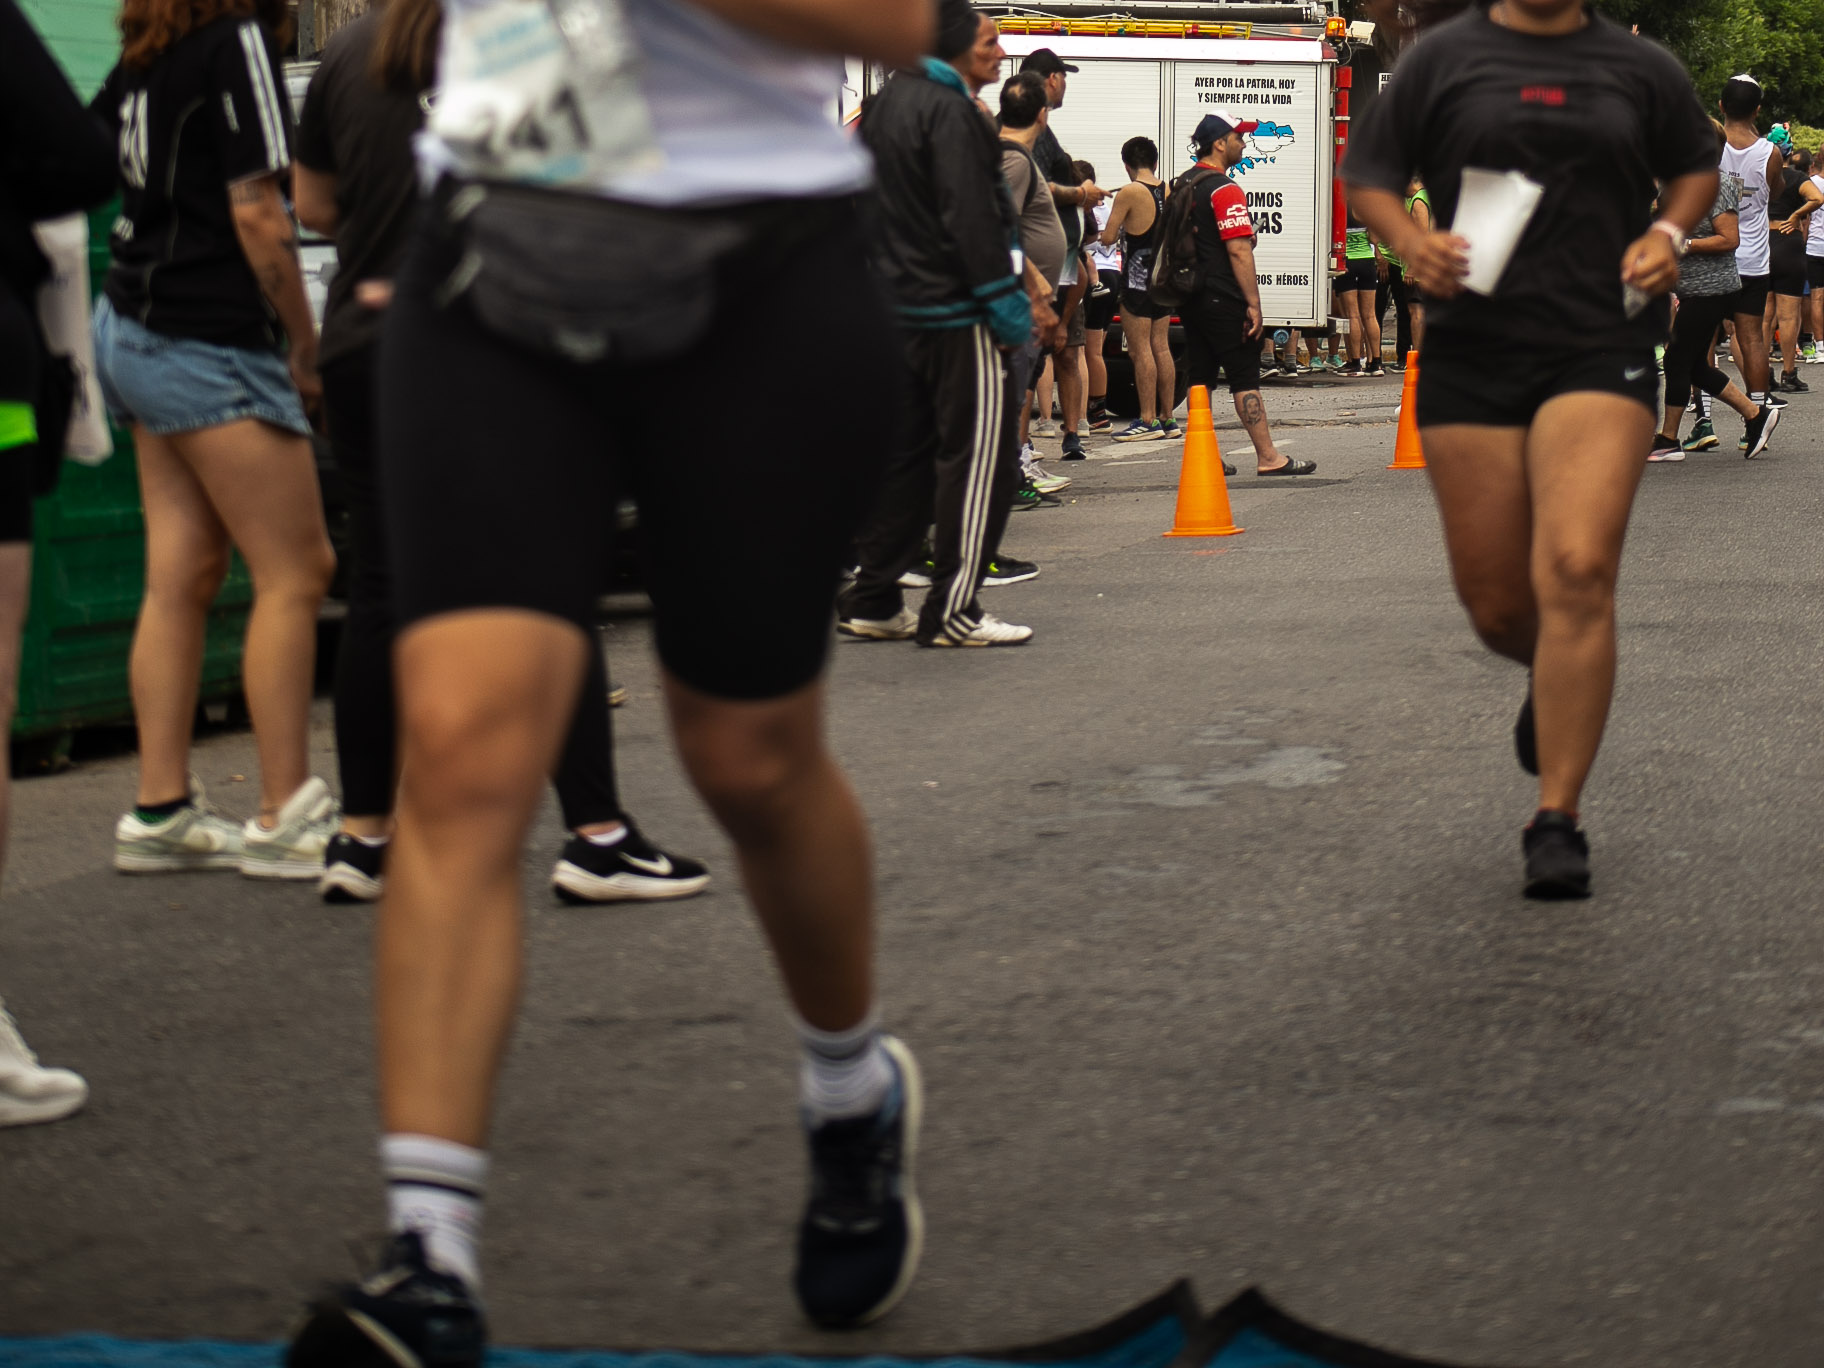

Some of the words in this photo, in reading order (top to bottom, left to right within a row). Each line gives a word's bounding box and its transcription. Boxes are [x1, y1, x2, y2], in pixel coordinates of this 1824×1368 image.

[1194, 77, 1214, 87] AYER
[1216, 78, 1233, 88] POR
[1235, 78, 1245, 88] LA
[1246, 78, 1277, 90] PATRIA,
[1279, 79, 1295, 89] HOY
[1198, 93, 1203, 103] Y
[1204, 93, 1240, 103] SIEMPRE
[1242, 94, 1258, 104] POR
[1260, 94, 1270, 104] LA
[1272, 94, 1292, 104] VIDA
[1246, 191, 1283, 208] OMOS
[1276, 273, 1309, 286] HÉROES
